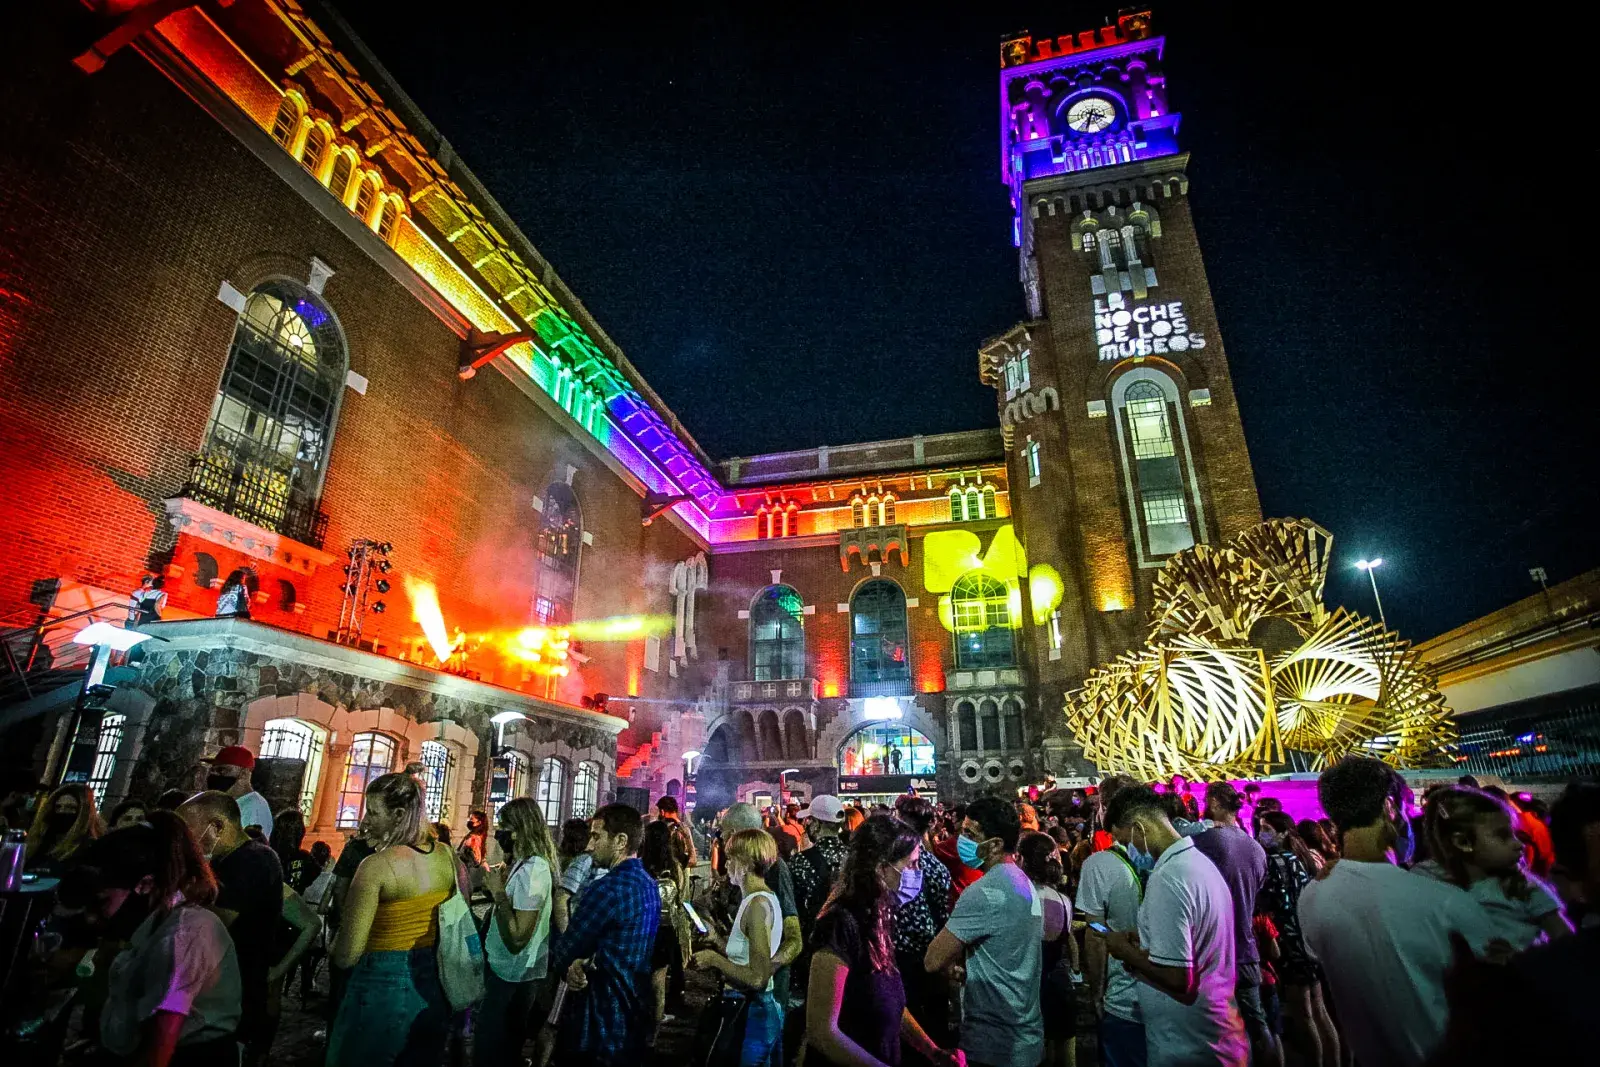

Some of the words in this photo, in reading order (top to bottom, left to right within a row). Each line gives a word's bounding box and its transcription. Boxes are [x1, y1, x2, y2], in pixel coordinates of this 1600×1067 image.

[1094, 292, 1125, 314] LA
[1095, 302, 1183, 330] NOCHE
[1096, 325, 1130, 345] DE
[1138, 317, 1189, 339] LOS
